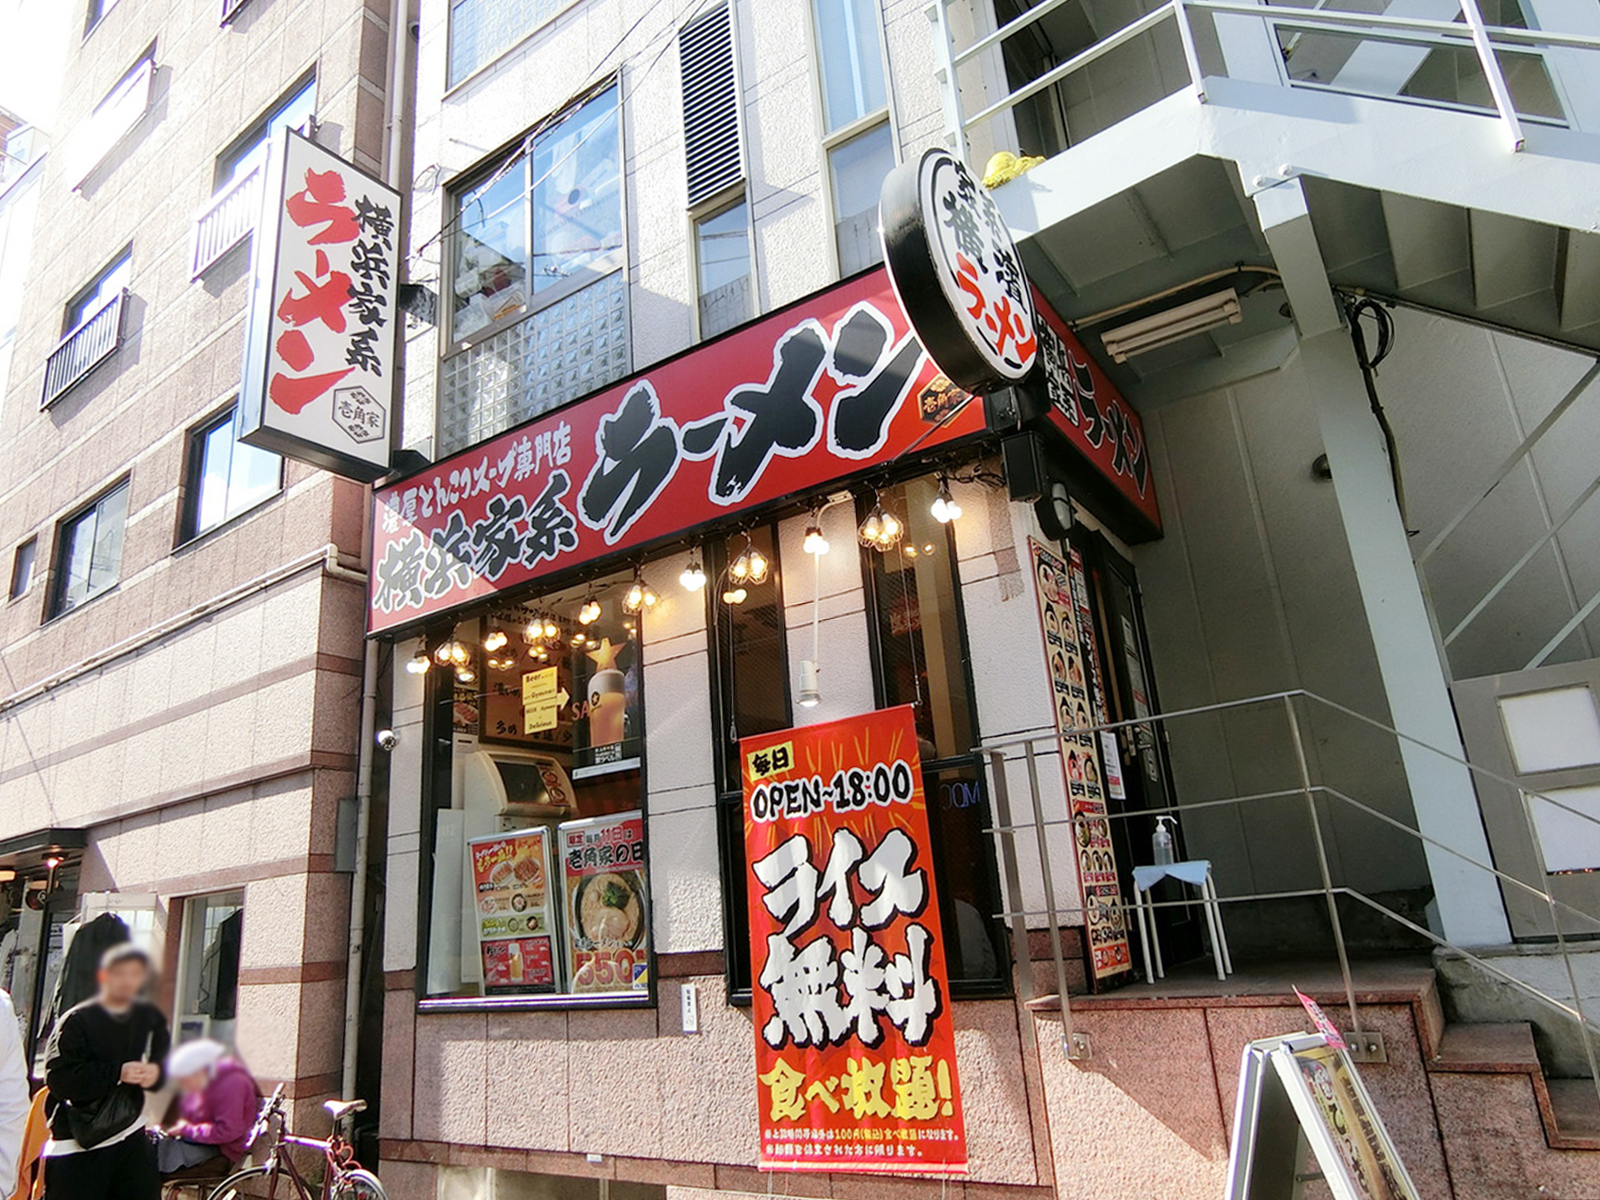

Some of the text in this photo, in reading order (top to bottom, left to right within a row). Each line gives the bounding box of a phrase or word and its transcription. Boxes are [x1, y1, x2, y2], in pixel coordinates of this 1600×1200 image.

[269, 166, 361, 415] ラーメン
[345, 194, 394, 379] 横浜家系
[956, 252, 1038, 364] ラーメン
[381, 420, 572, 534] 濃厚とんこつスープ専門店
[576, 300, 927, 545] ラーメン
[372, 469, 579, 614] 横浜家系
[752, 746, 789, 776] 毎日
[752, 828, 928, 942] ライス
[758, 922, 943, 1050] 無料
